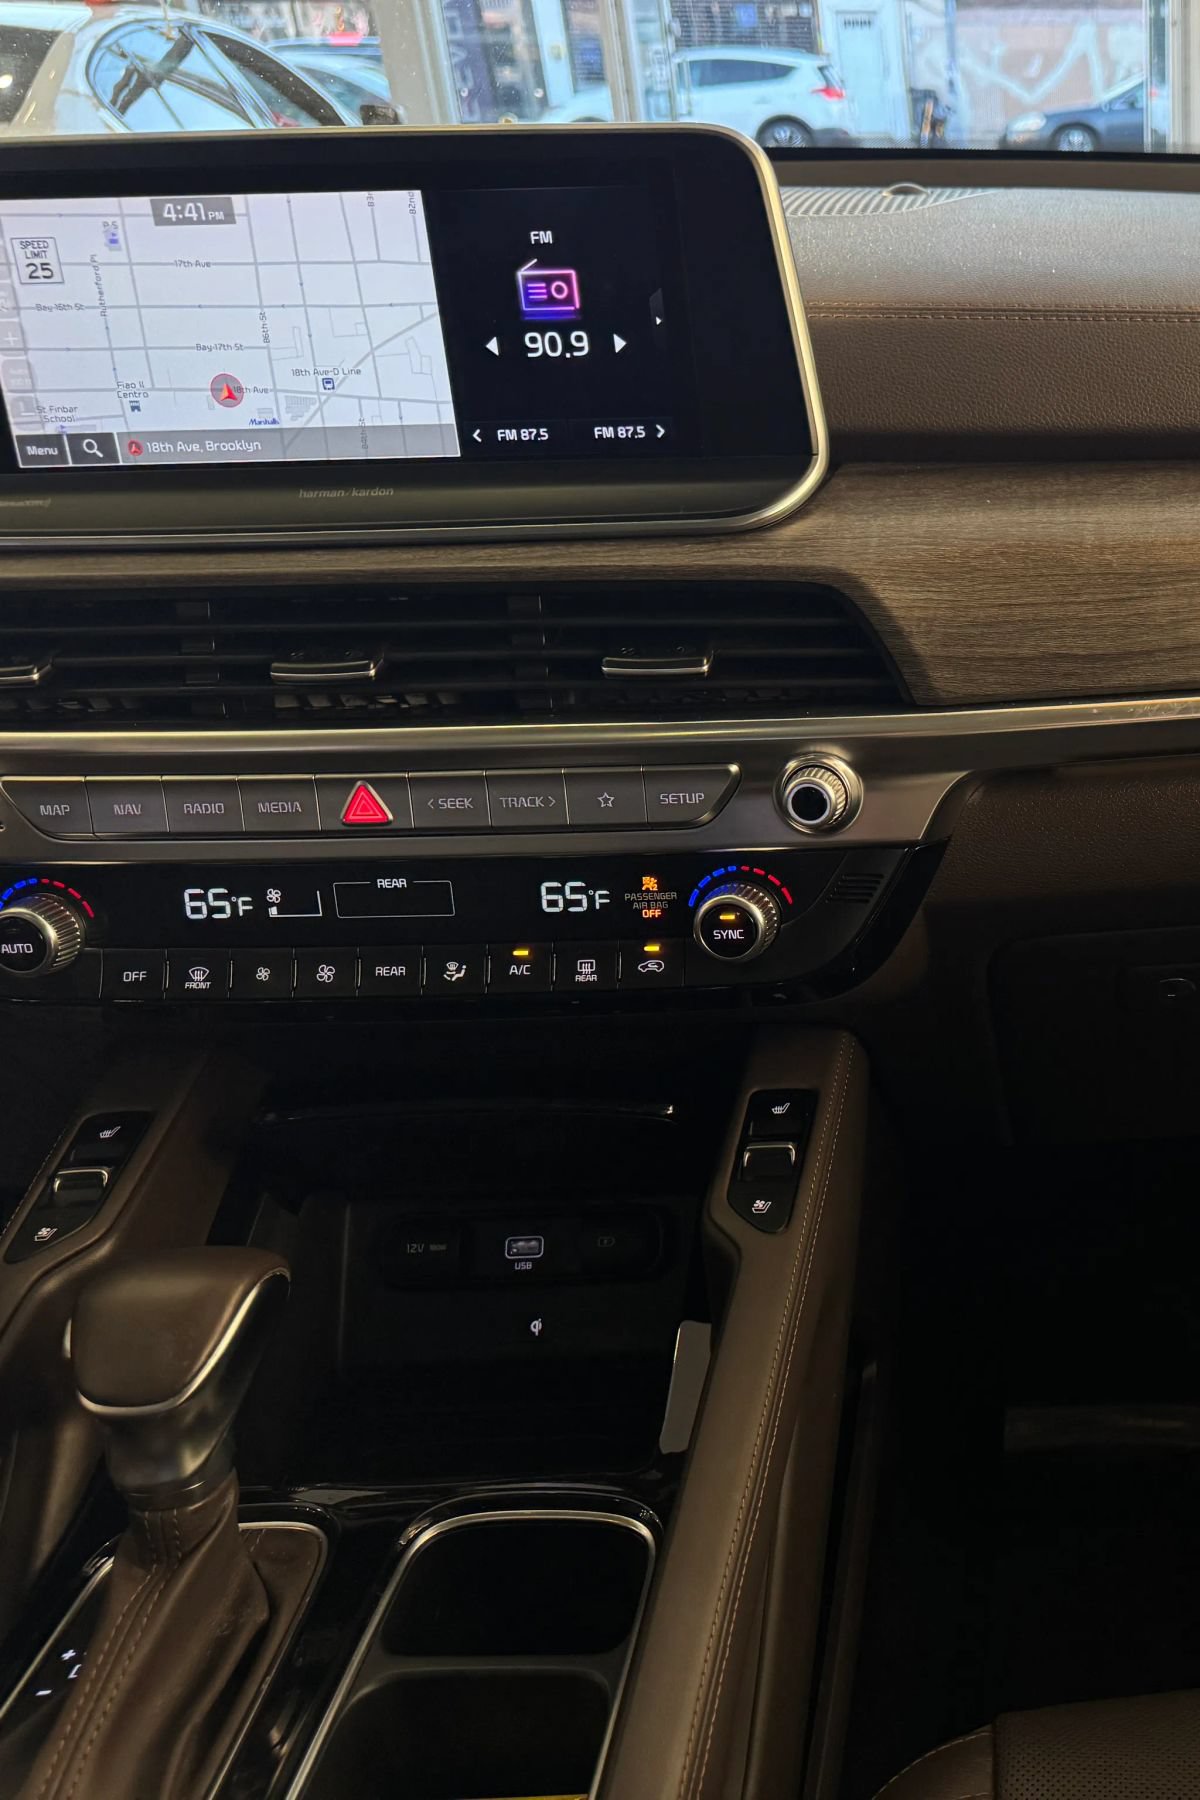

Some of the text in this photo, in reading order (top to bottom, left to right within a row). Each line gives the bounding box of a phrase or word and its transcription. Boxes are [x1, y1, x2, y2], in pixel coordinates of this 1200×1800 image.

[163, 202, 225, 222] 4:41 PM
[530, 231, 553, 244] FM
[20, 240, 49, 250] SPEED
[25, 250, 48, 259] LIMIT
[174, 259, 211, 269] 17th Ave
[25, 262, 54, 280] 25
[92, 265, 108, 317] Rutherford
[35, 303, 53, 312] Bay
[74, 303, 85, 311] St
[259, 311, 271, 344] 86th St
[195, 343, 244, 352] Bay 17th St
[523, 331, 590, 358] 90.9
[291, 367, 362, 377] 18th Ave-D Line
[116, 390, 150, 399] Centro
[233, 385, 269, 394] 18th Ave
[49, 405, 78, 413] Finbar
[43, 414, 76, 423] School
[248, 418, 280, 426] Marshalls
[497, 427, 549, 441] FM 87.5
[594, 425, 646, 439] FM 87.5
[26, 445, 58, 456] Menu
[146, 440, 262, 455] 18th Ave, Brooklyn
[438, 797, 474, 810] SEEK
[500, 796, 545, 808] TRACK
[660, 792, 705, 805] SETUP
[40, 805, 70, 817] MAP
[113, 803, 142, 815] NAV
[183, 803, 225, 815] RADIO
[257, 801, 302, 814] MEDIA
[377, 878, 407, 889] REAR
[624, 892, 678, 901] PASSENGER
[632, 901, 669, 910] AIR BAG
[642, 909, 662, 918] OFF
[713, 929, 745, 940] SYNC
[0, 943, 34, 954] AUTO
[375, 966, 406, 976] REAR
[509, 964, 531, 976] A/C
[123, 970, 147, 982] OFF
[574, 973, 598, 982] REAR
[184, 981, 211, 989] FRONT
[407, 1243, 424, 1254] 12V
[514, 1261, 533, 1271] USB
